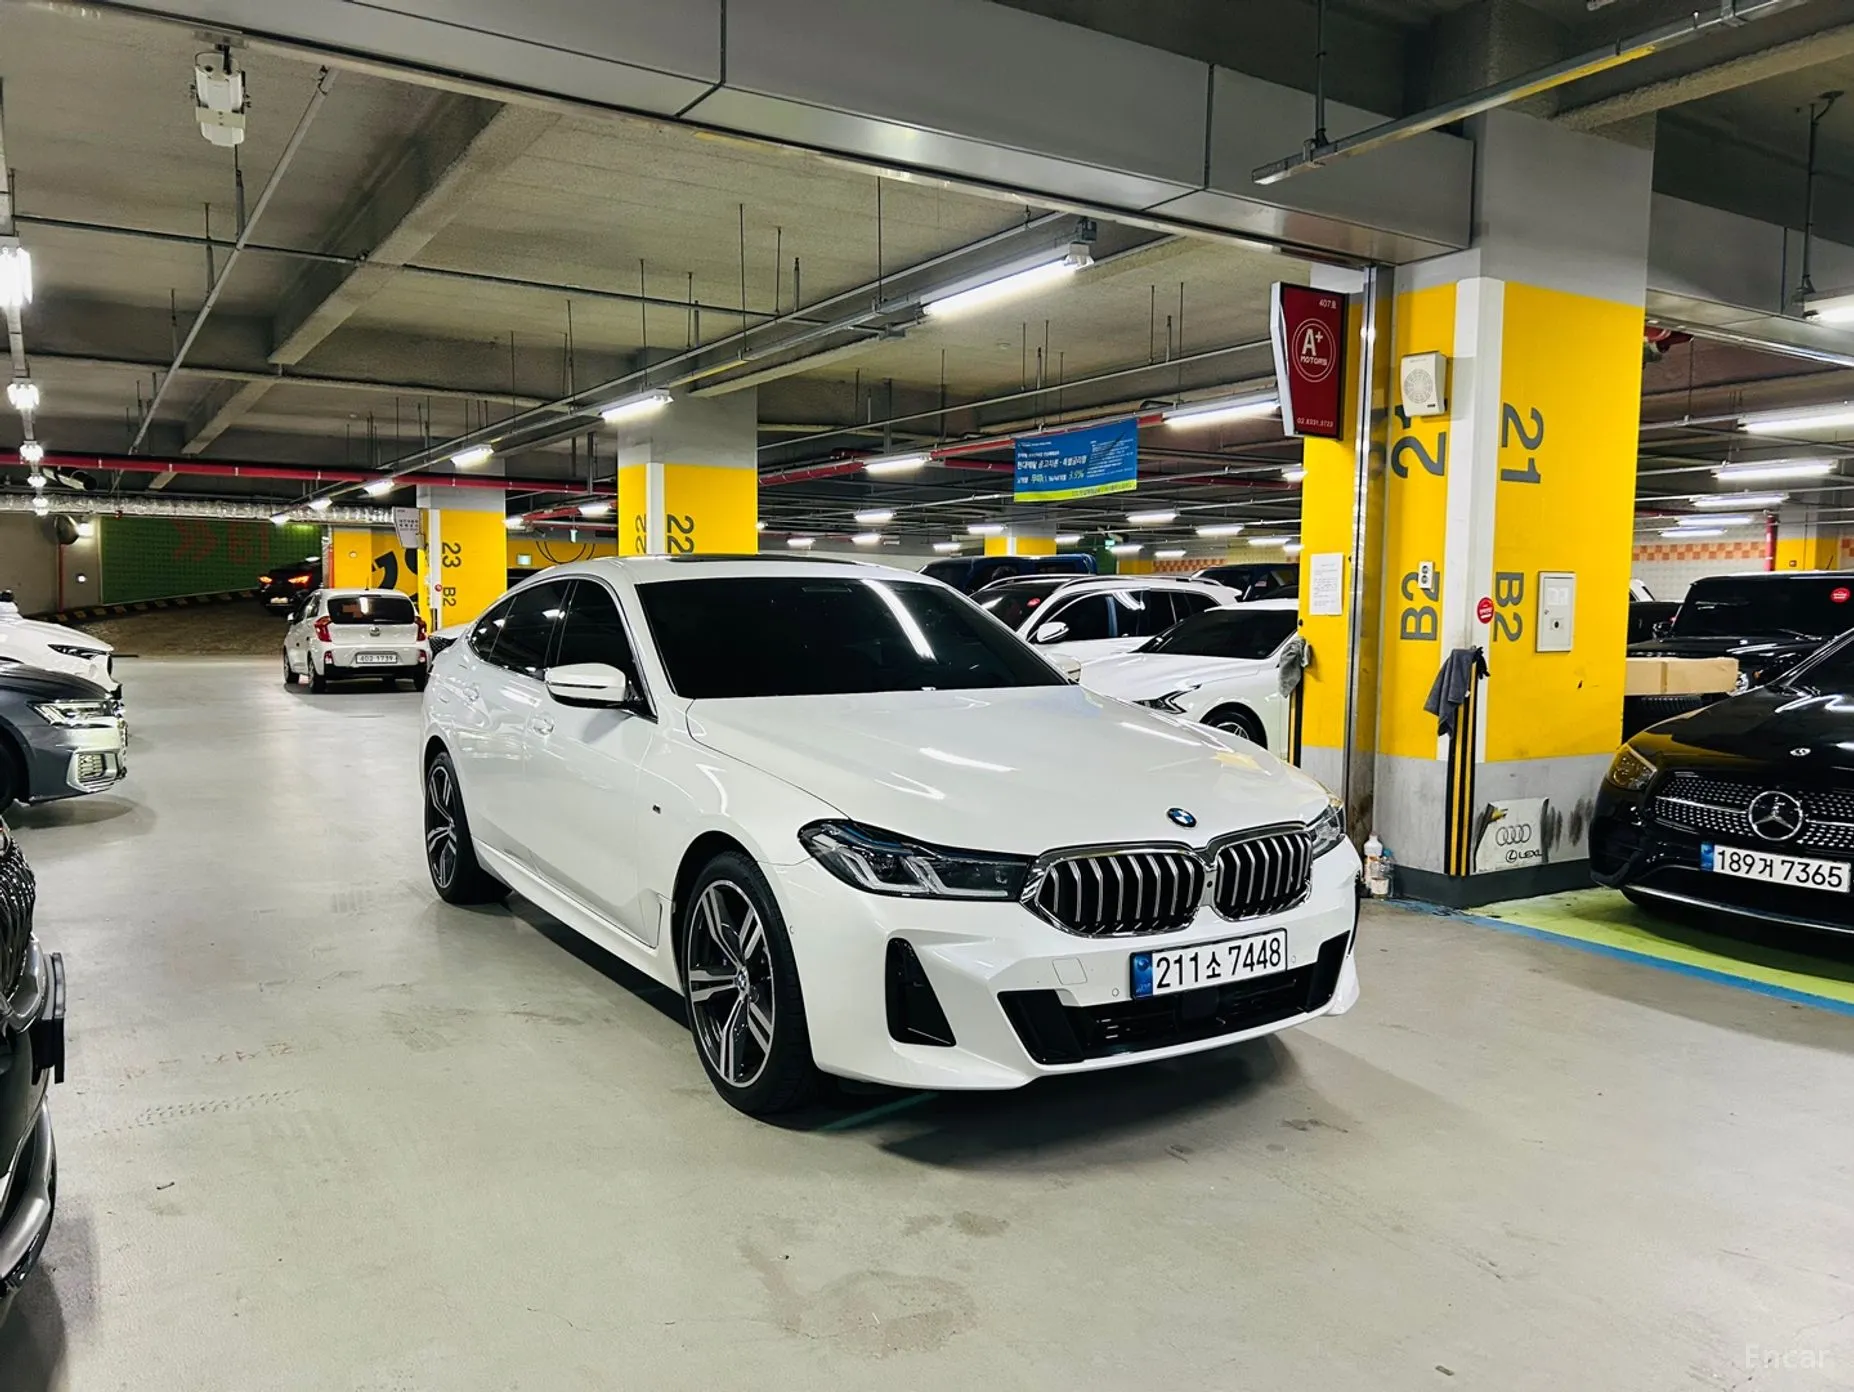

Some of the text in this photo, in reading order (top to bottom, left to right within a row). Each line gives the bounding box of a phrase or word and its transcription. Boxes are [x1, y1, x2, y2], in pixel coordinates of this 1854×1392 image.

[1300, 356, 1328, 366] MOTORS
[1302, 328, 1323, 356] A+
[1501, 402, 1544, 484] 21
[667, 513, 694, 554] 22
[442, 542, 461, 568] 23
[443, 586, 456, 607] B2
[1400, 571, 1440, 641] B2
[1493, 572, 1524, 642] B2
[1718, 850, 1842, 888] 189거 7365
[1156, 937, 1281, 988] 211소 7448
